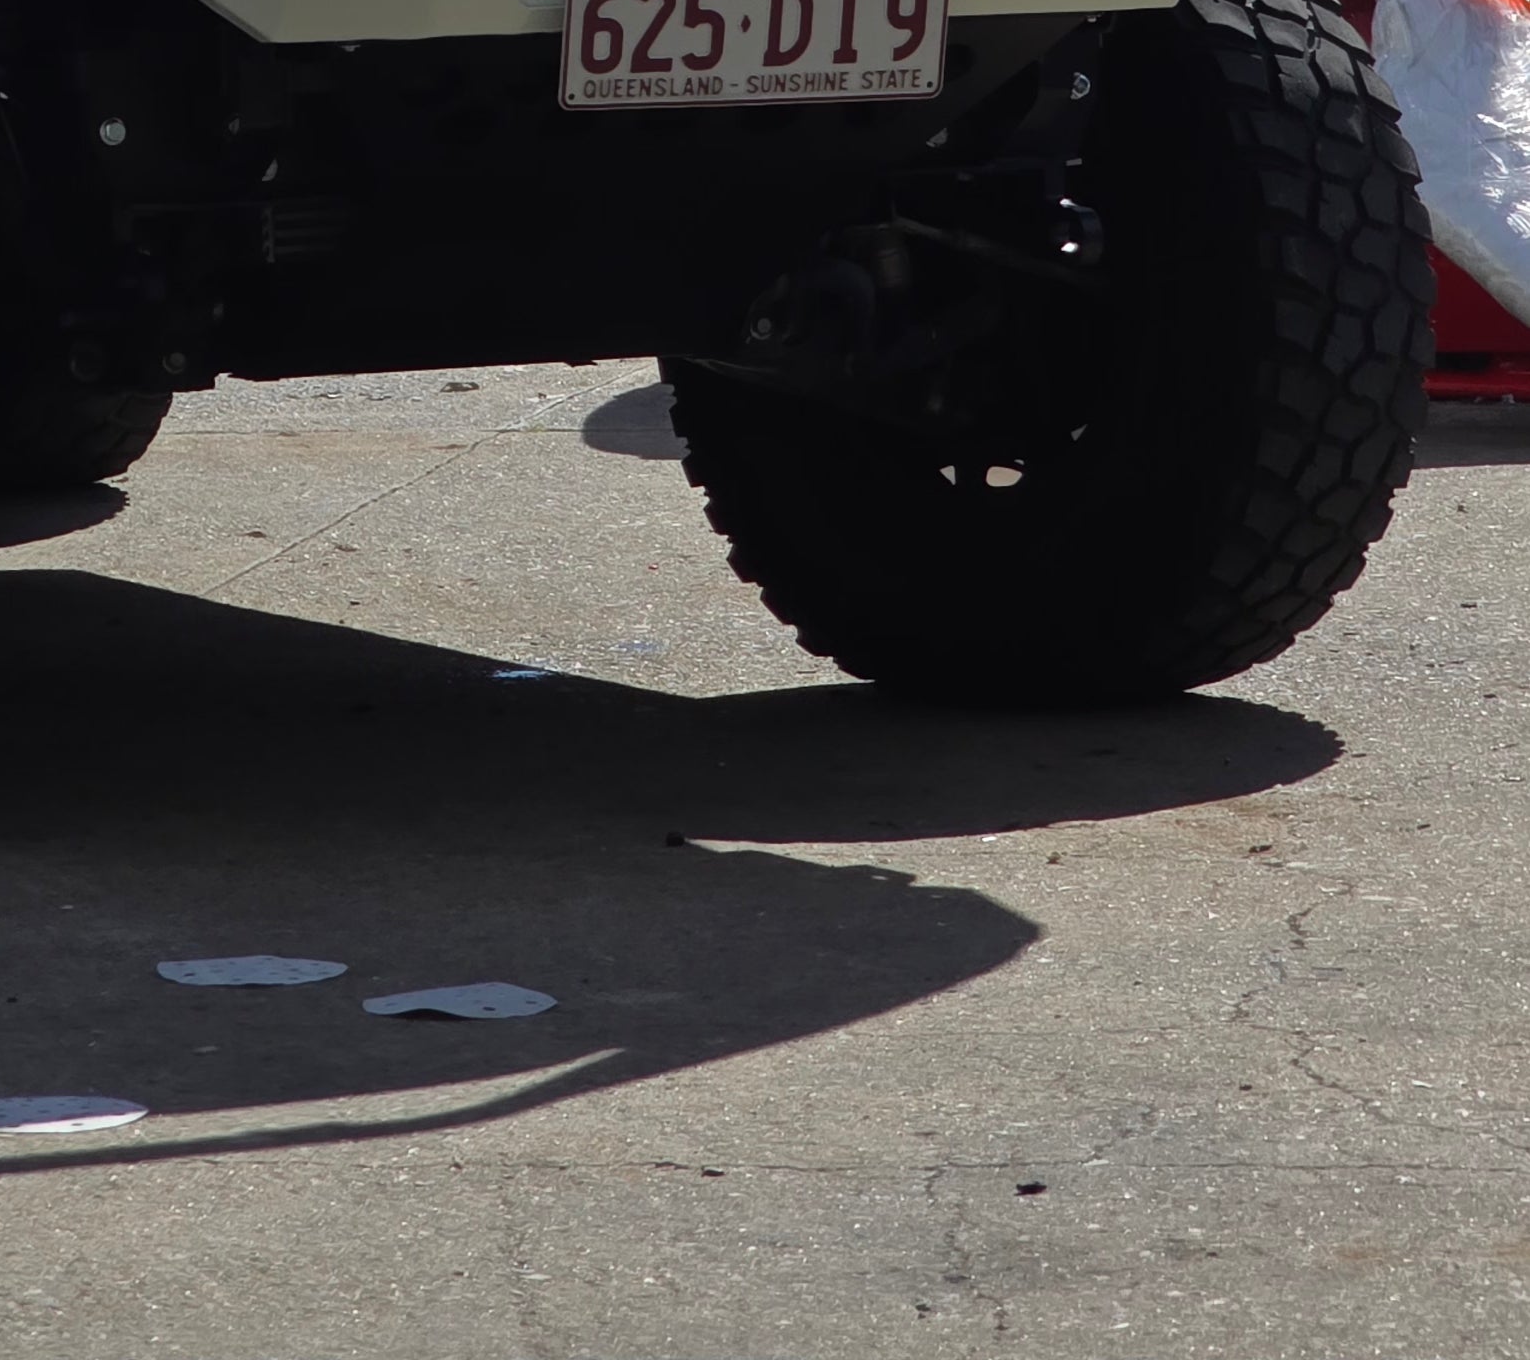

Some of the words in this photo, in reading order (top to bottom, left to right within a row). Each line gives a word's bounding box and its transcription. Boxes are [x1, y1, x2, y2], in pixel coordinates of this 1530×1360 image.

[583, 75, 724, 99] QUEENSLAND
[746, 71, 849, 94] SUNSHINE
[861, 68, 922, 90] STATE
